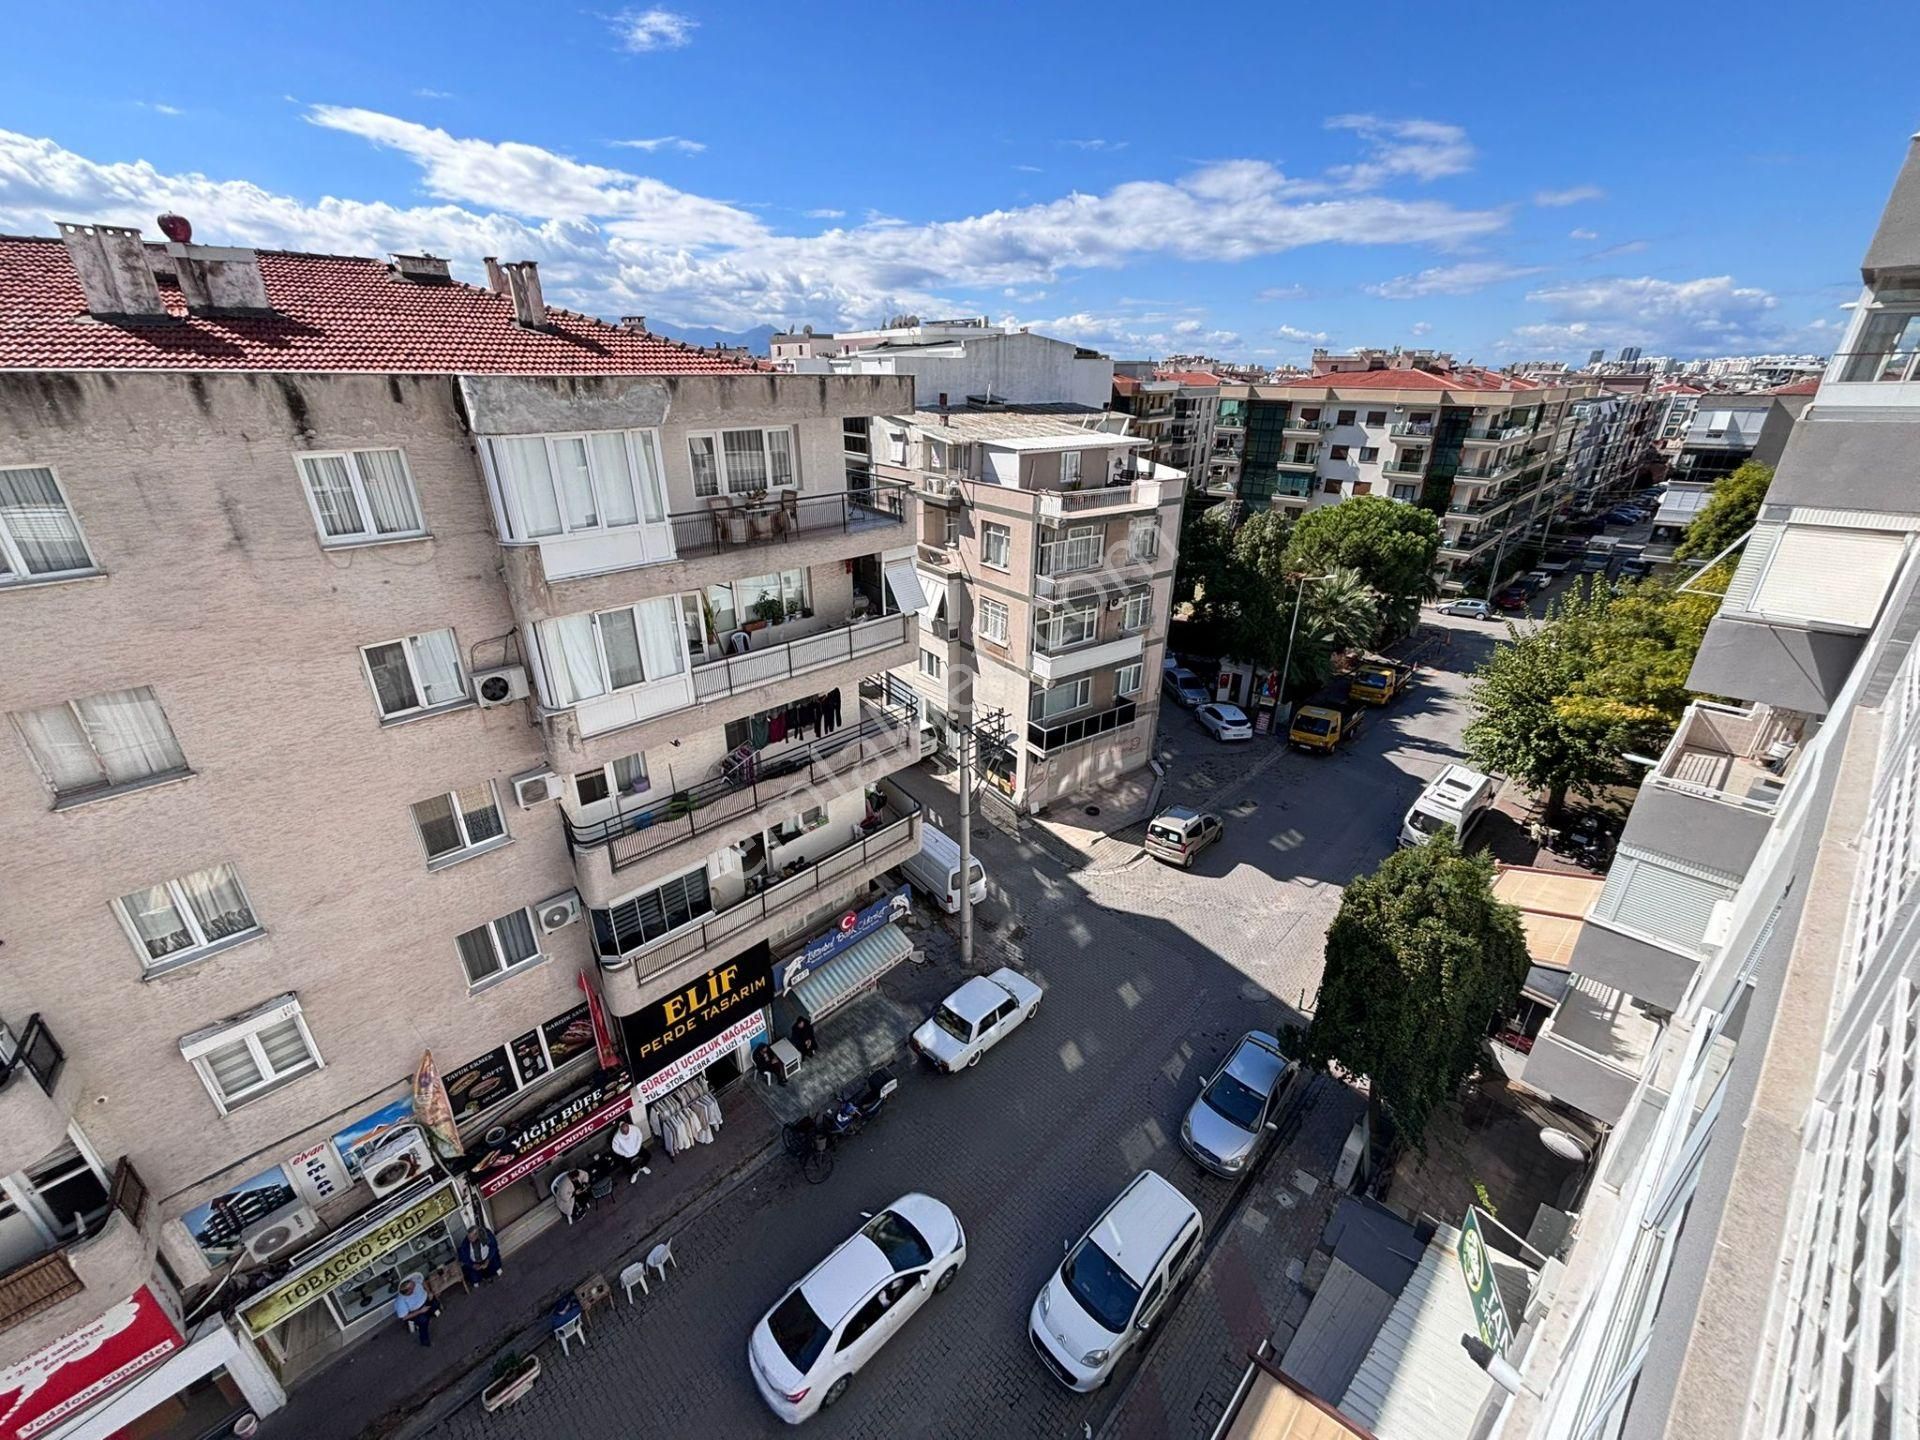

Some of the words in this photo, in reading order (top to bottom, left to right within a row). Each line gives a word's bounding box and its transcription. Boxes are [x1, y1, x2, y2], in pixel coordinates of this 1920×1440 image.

[640, 1019, 696, 1058] PERDE
[701, 976, 766, 1022] TASARIM
[662, 964, 738, 1027] ELİF
[640, 1057, 680, 1095] SÜREKLİ
[681, 1038, 721, 1070] UCUZLUK
[721, 1012, 763, 1047] MAĞAZASI
[645, 1087, 661, 1102] TÜL
[665, 1074, 685, 1091] STOR
[688, 1057, 711, 1080] ZEBRA
[510, 1154, 545, 1180] KÖFTE
[554, 1123, 595, 1153] SANDVİÇ
[603, 1104, 627, 1122] TOST
[511, 1114, 560, 1150] YİĞİT
[562, 1088, 604, 1121] BÜFE
[280, 1243, 373, 1307] TOBACCO
[378, 1208, 428, 1247] SHOP
[21, 1386, 100, 1435] Vodafone
[102, 1342, 171, 1386] SüperNet
